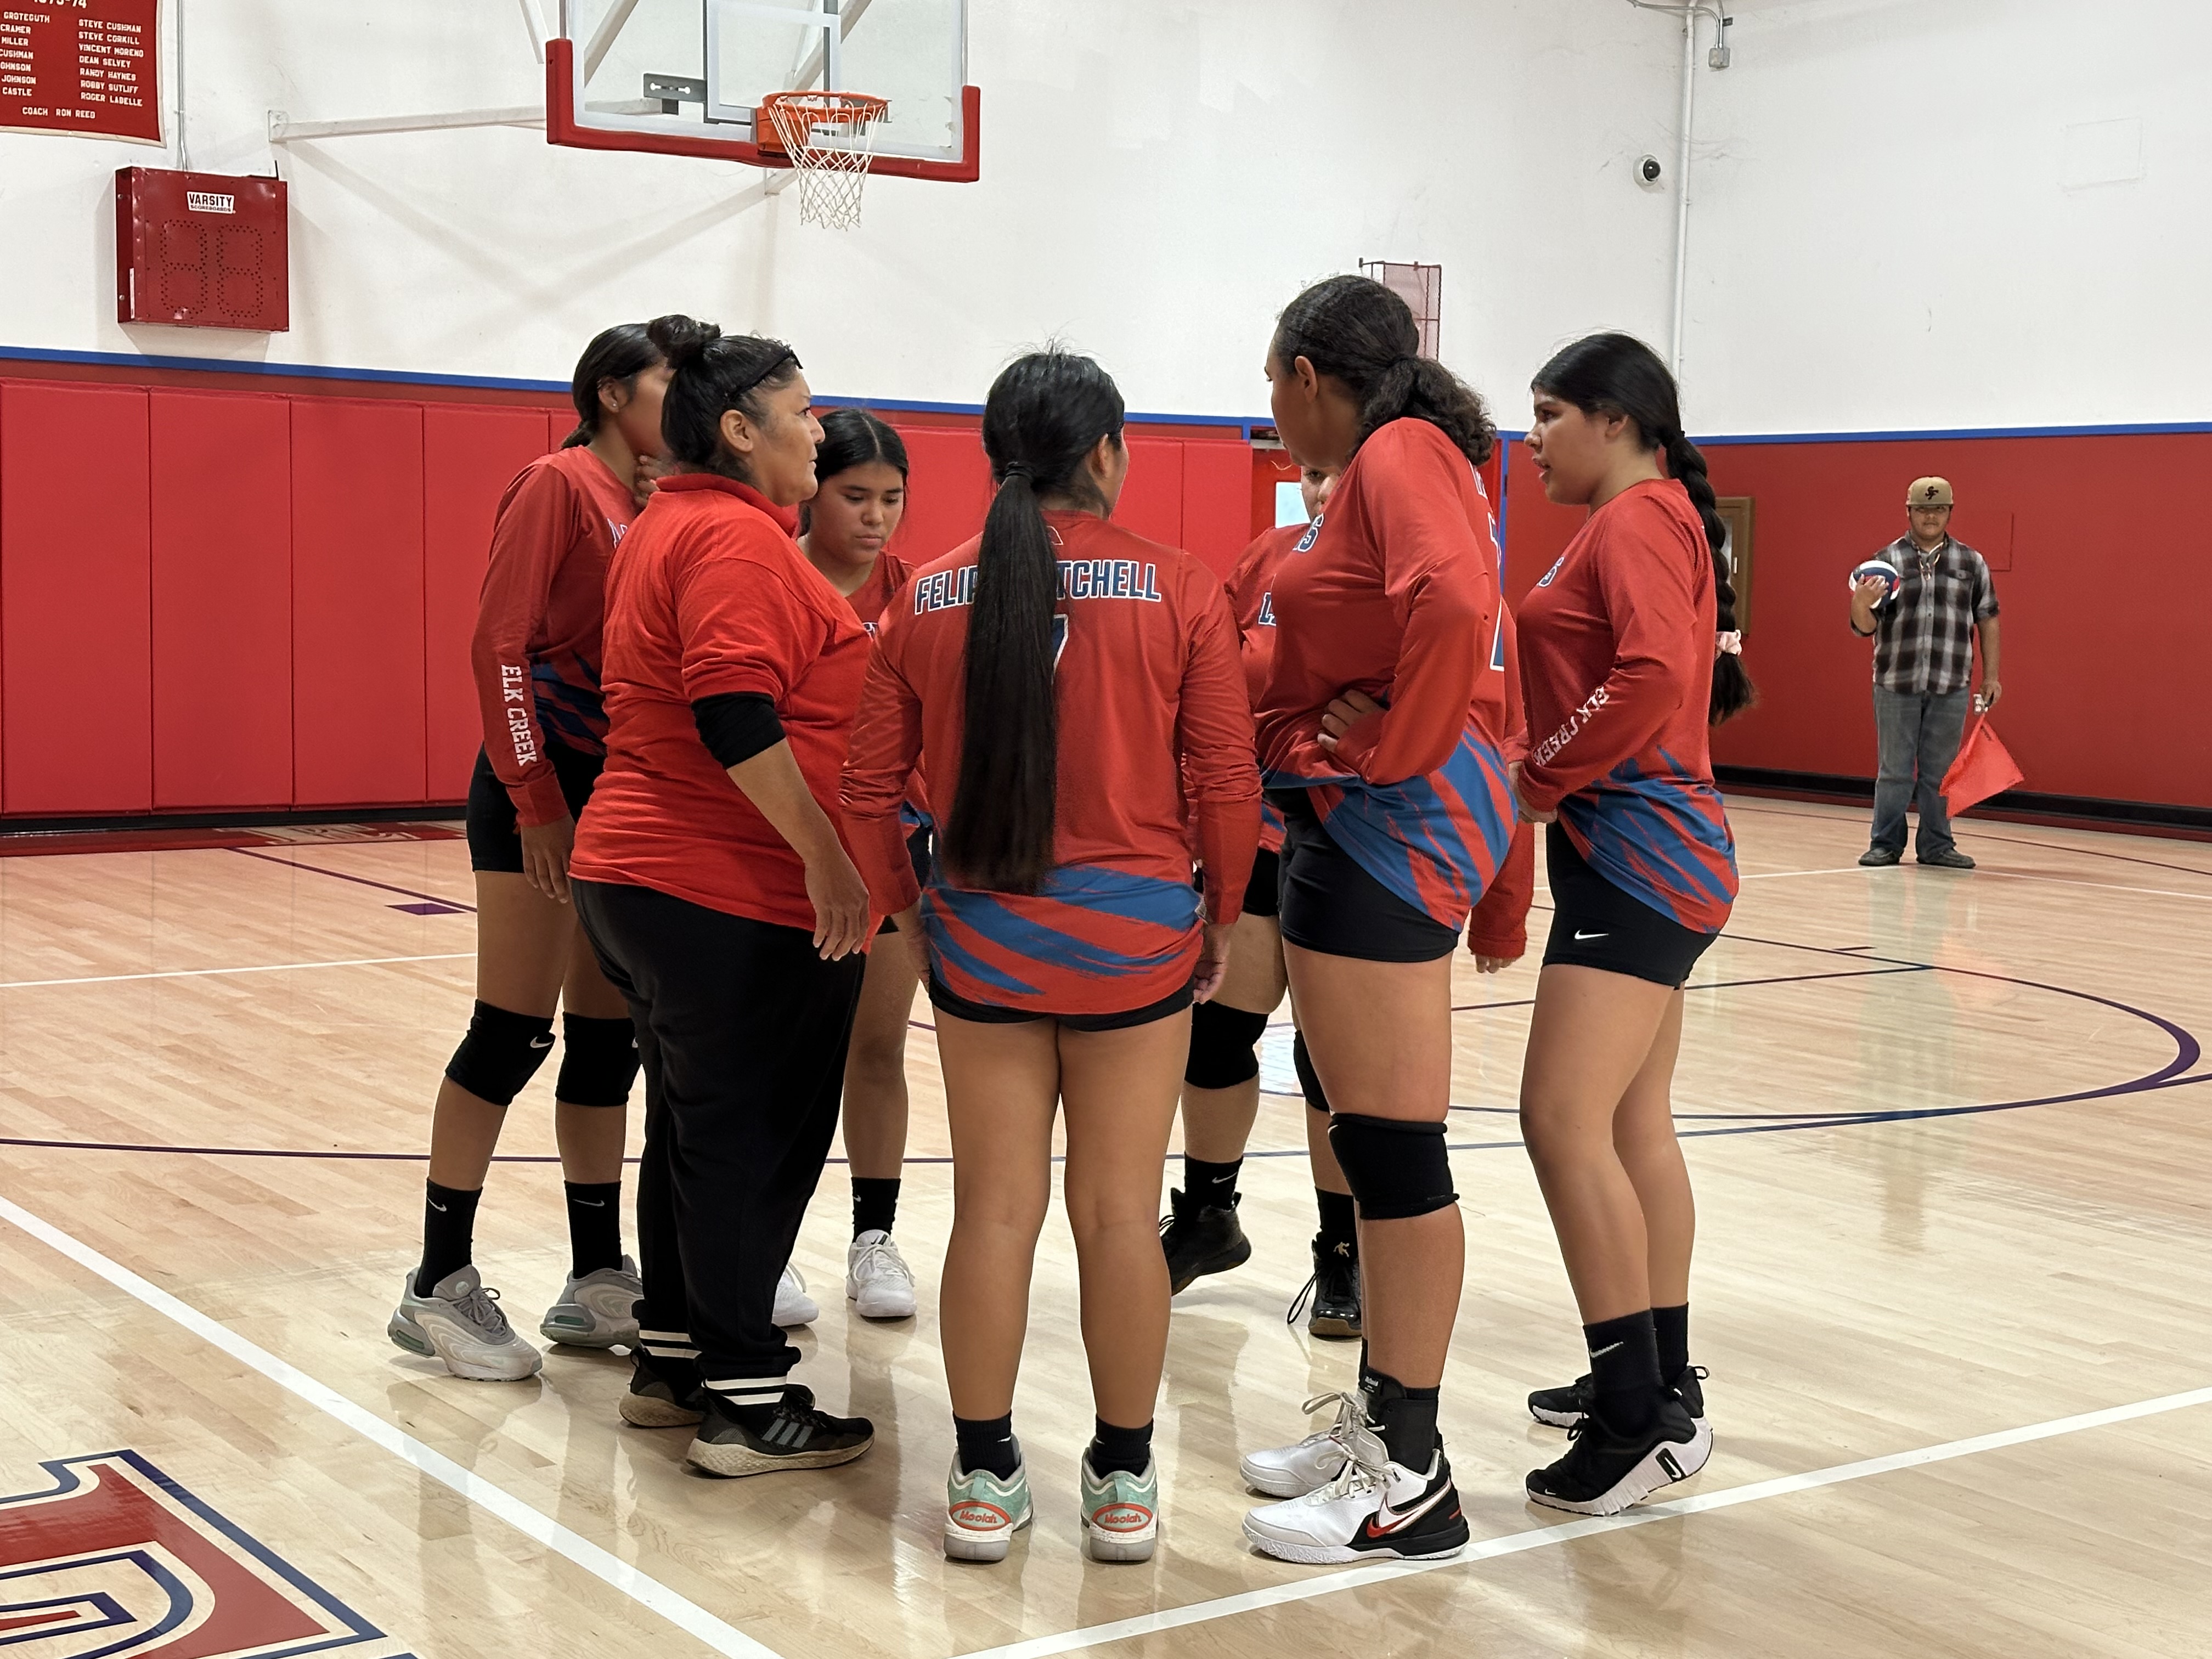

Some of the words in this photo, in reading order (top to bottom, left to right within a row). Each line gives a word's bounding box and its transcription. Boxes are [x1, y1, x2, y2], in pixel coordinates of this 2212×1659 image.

[1, 24, 31, 34] CRAMER
[78, 19, 103, 29] STEVE
[106, 22, 142, 33] CUSHMAN
[2, 36, 29, 46] MILLER
[78, 31, 103, 41] STEVE
[0, 48, 33, 59] CUSHMAN
[78, 43, 111, 54] VINCENT
[114, 47, 144, 57] MORENO
[0, 61, 31, 71] OHNSON
[79, 55, 99, 65] DEAN
[103, 58, 131, 68] SELVEY
[1, 75, 36, 84] JOHNSON
[80, 67, 104, 78] RANDY
[108, 71, 136, 81] HAYNES
[2, 87, 32, 96] CASTLE
[108, 83, 138, 94] SUTLIFF
[81, 92, 105, 102] ROGER
[22, 107, 48, 116] COACH
[56, 108, 72, 117] RON
[75, 110, 95, 119] REED
[189, 194, 232, 207] VARSITY
[1056, 559, 1161, 602] TCHELL
[501, 664, 523, 702] ELK
[507, 707, 537, 766] CREEK
